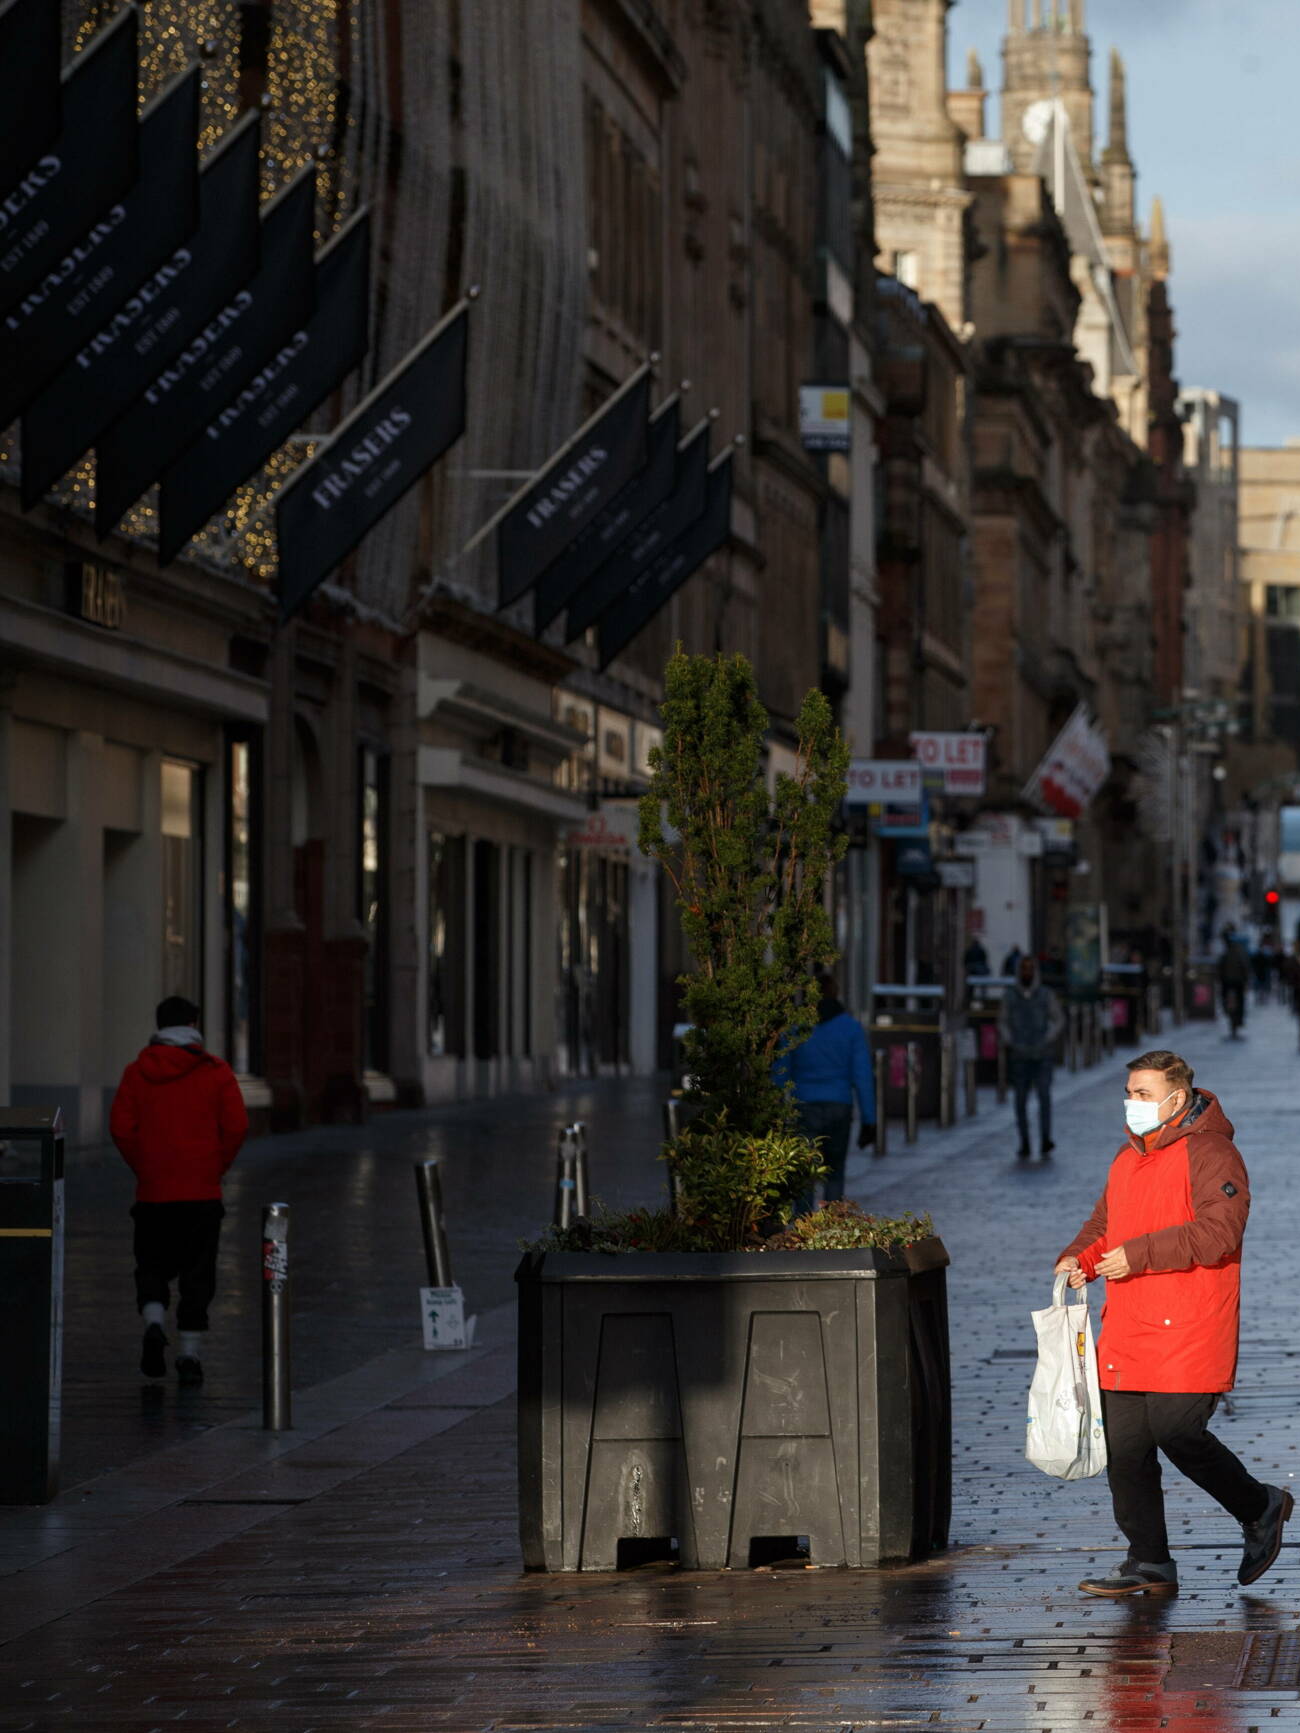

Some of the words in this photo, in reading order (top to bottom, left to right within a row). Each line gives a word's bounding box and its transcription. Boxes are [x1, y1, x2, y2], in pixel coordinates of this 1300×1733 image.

[312, 405, 413, 510] FRASERS
[526, 445, 609, 529] FRASERS
[847, 769, 874, 787] TO
[880, 769, 921, 787] LET
[912, 738, 941, 765] TO
[944, 738, 983, 765] LET
